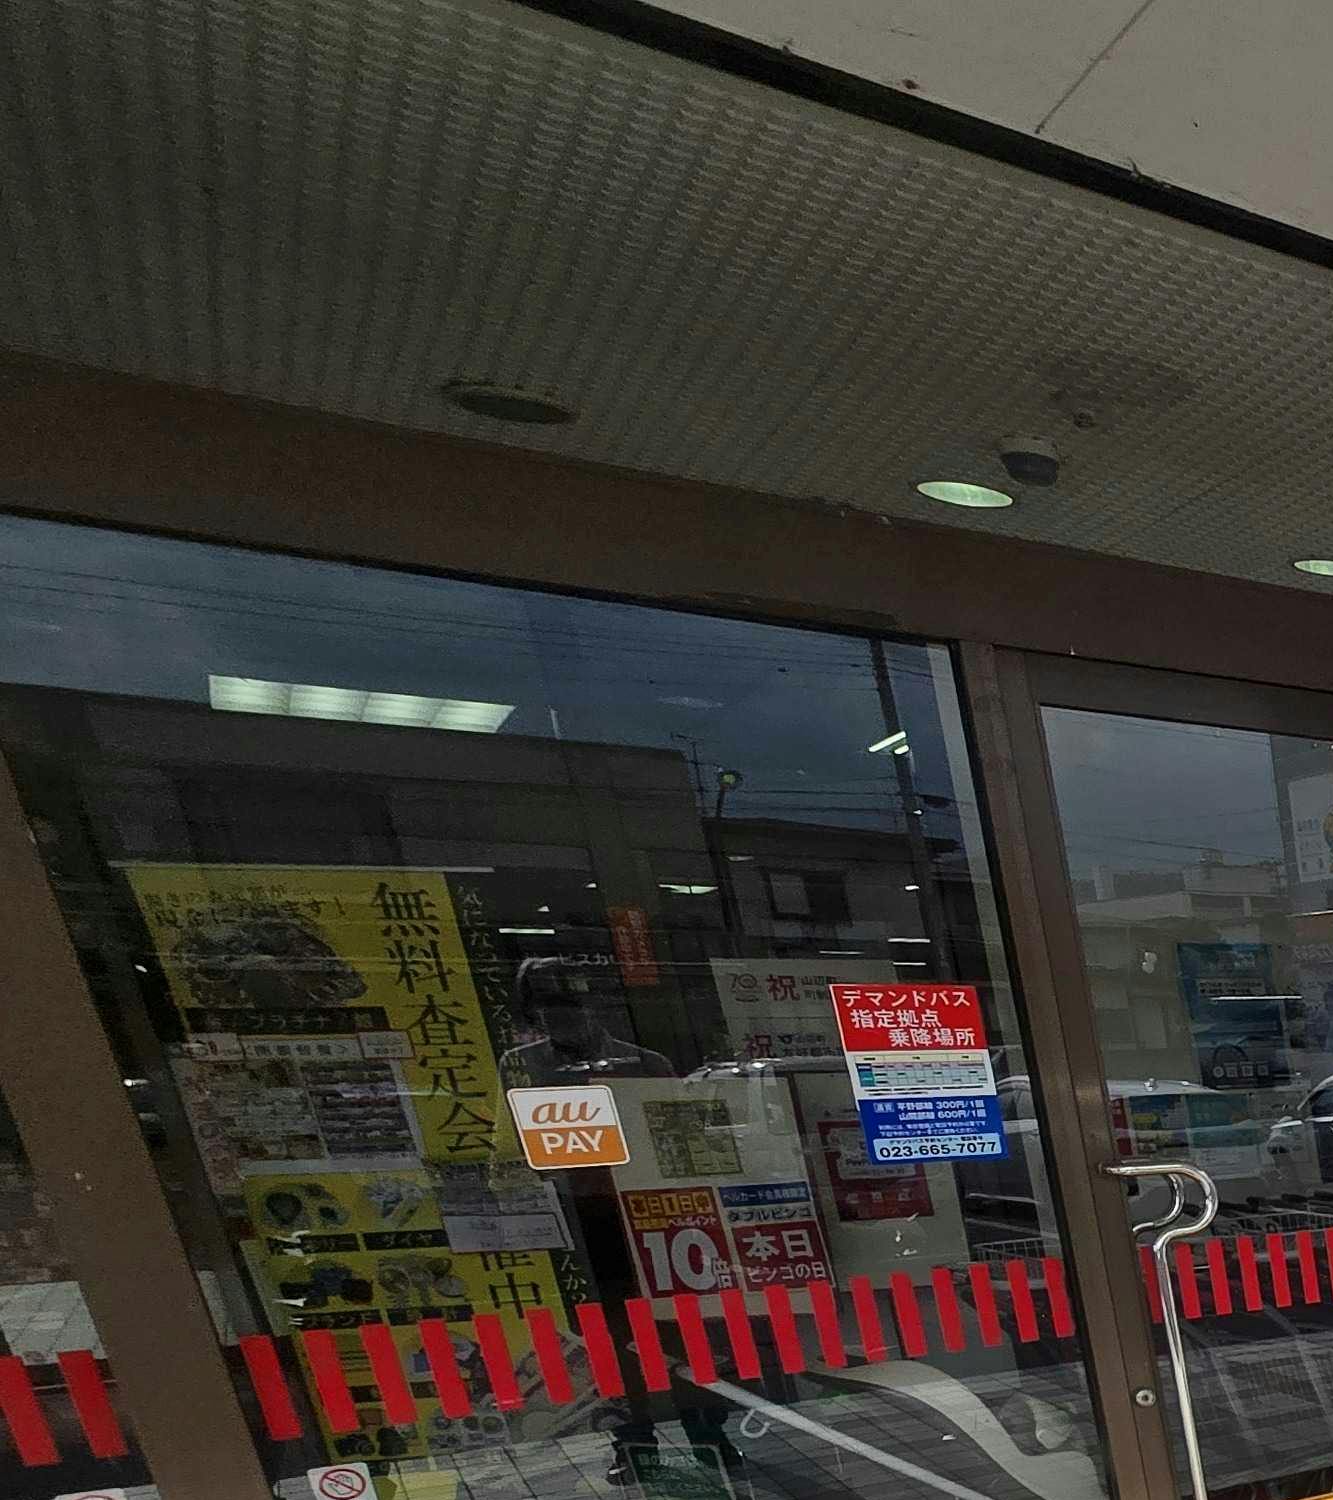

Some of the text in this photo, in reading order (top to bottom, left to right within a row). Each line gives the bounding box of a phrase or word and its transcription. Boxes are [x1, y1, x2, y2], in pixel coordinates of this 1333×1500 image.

[842, 990, 971, 1007] デマンドバス
[851, 1009, 942, 1028] 指定拠点
[888, 1028, 976, 1047] 乗降場所
[532, 1100, 601, 1124] au
[540, 1130, 604, 1155] PAY
[879, 1141, 997, 1159] 023-665-7077
[742, 1229, 815, 1262] 本日
[748, 1261, 827, 1283] ビンゴの日
